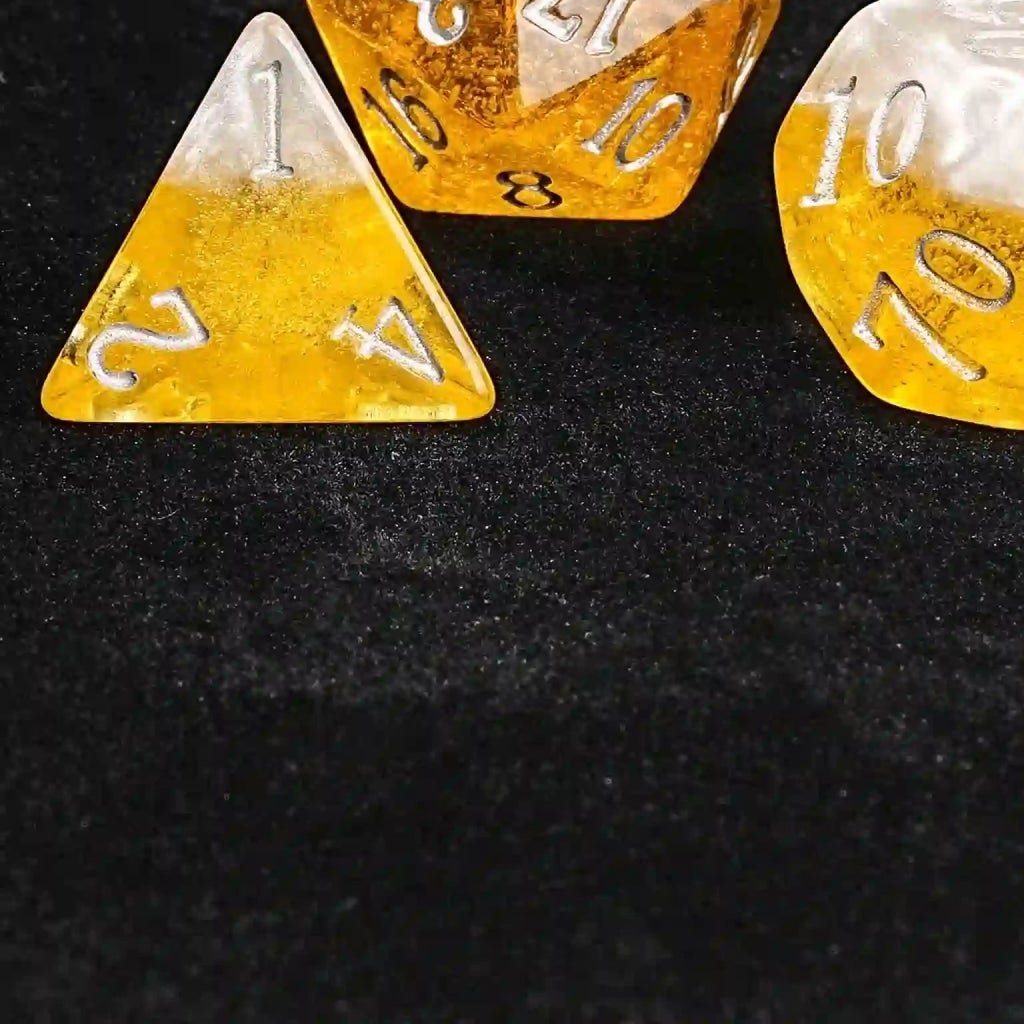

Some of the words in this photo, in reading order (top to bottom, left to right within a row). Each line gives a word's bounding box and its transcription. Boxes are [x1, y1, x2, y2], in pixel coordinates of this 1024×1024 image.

[250, 59, 294, 183] 1
[580, 77, 692, 172] 10
[800, 75, 927, 207] 10
[496, 170, 563, 210] 8
[87, 286, 210, 391] 2
[331, 296, 444, 384] 4
